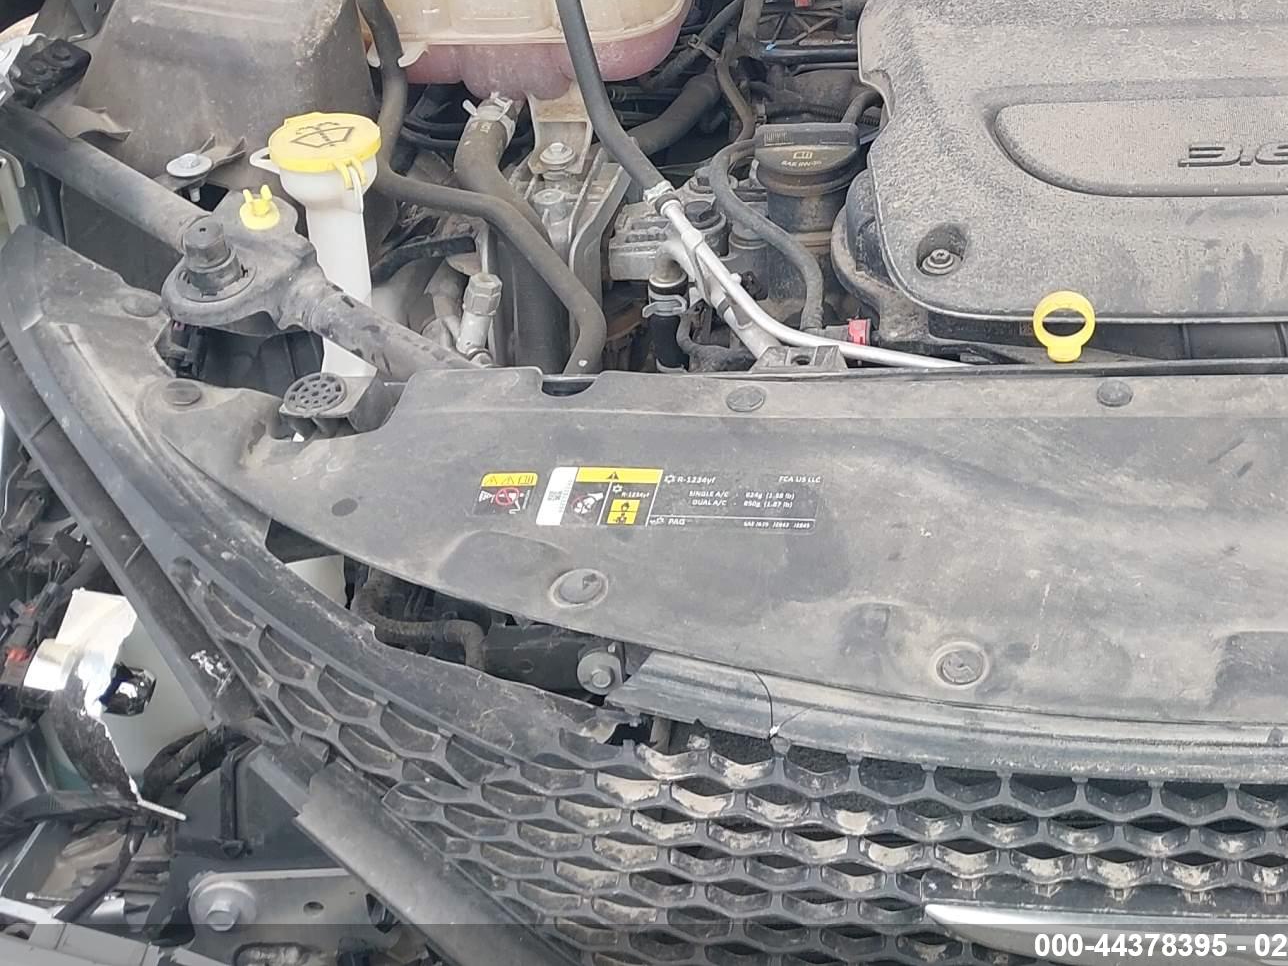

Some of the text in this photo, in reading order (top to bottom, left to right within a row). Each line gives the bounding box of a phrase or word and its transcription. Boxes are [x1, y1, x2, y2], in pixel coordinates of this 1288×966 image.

[676, 475, 717, 485] R-1234yf
[778, 475, 821, 484] FCA US LLC
[713, 499, 728, 507] A/C
[667, 518, 686, 526] PAG
